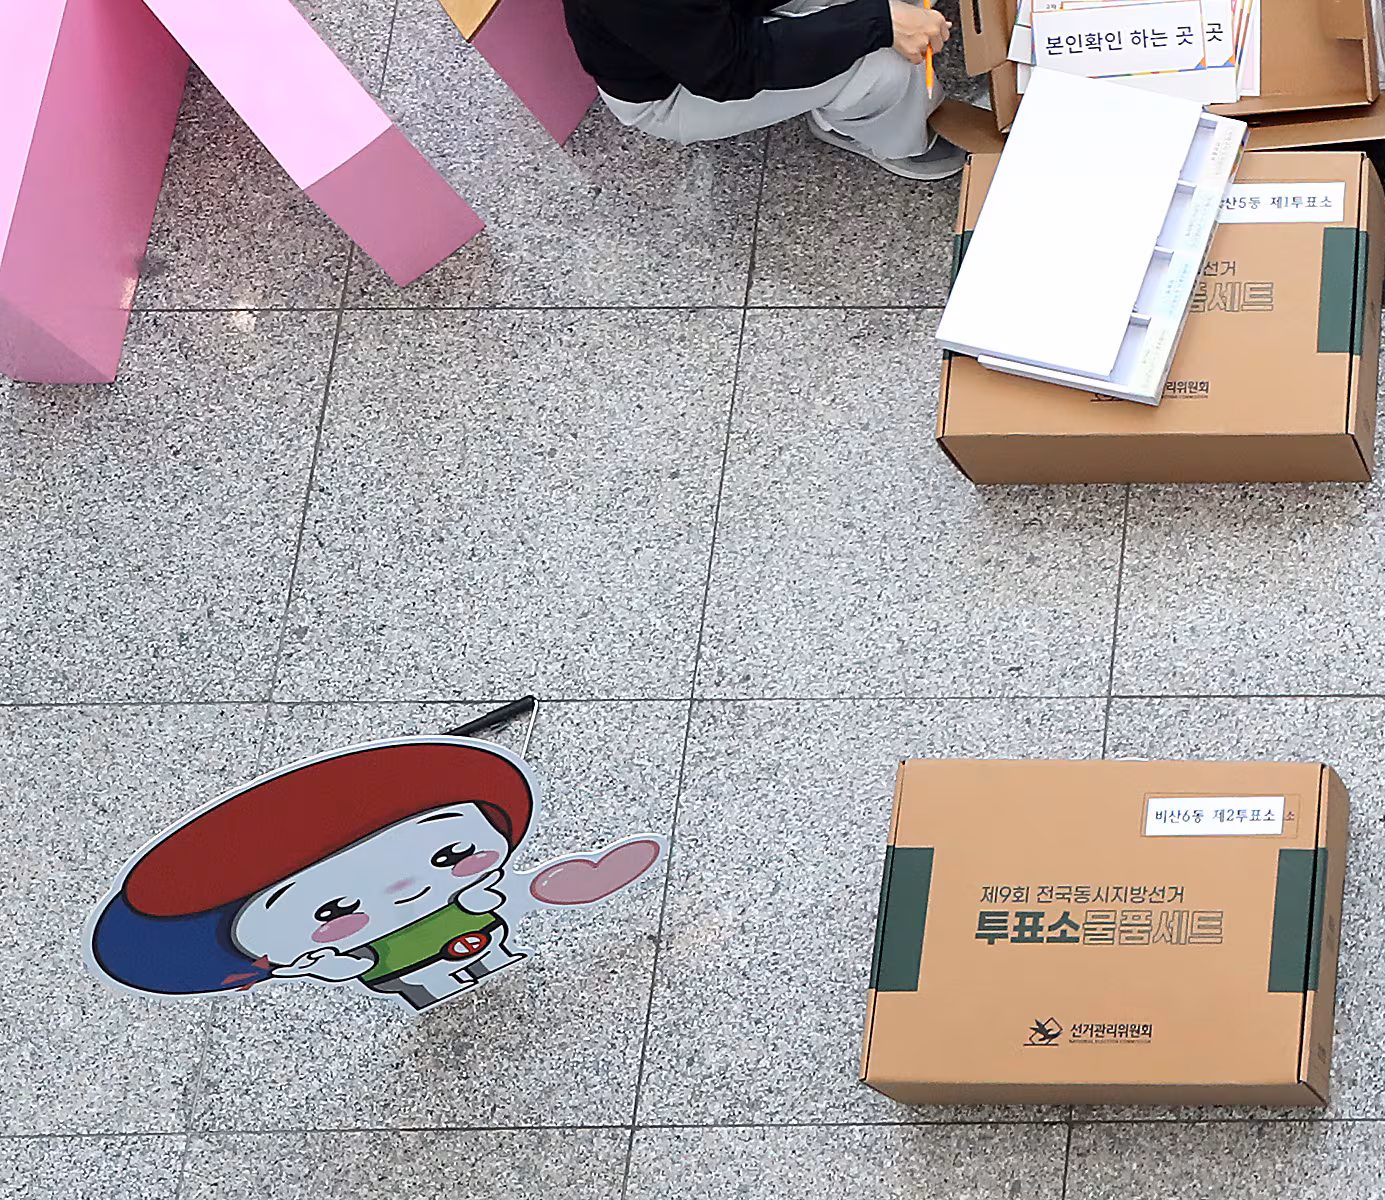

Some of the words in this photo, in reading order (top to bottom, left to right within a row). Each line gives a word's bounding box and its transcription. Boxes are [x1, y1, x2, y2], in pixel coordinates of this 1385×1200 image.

[1046, 31, 1122, 55] 본인확인
[1130, 29, 1168, 48] 하는
[1176, 26, 1193, 46] 곳
[1206, 23, 1223, 42] 곳
[1270, 196, 1332, 210] 제1투표소
[1162, 380, 1210, 395] 리위원회
[1156, 809, 1205, 824] 비산6동
[1213, 809, 1276, 822] 제2투표소
[981, 886, 1029, 903] 제9회
[1037, 885, 1185, 904] 전국동시지방선거
[975, 910, 1223, 945] 투표소물품세트
[1070, 1022, 1153, 1039] 선거관리위원회
